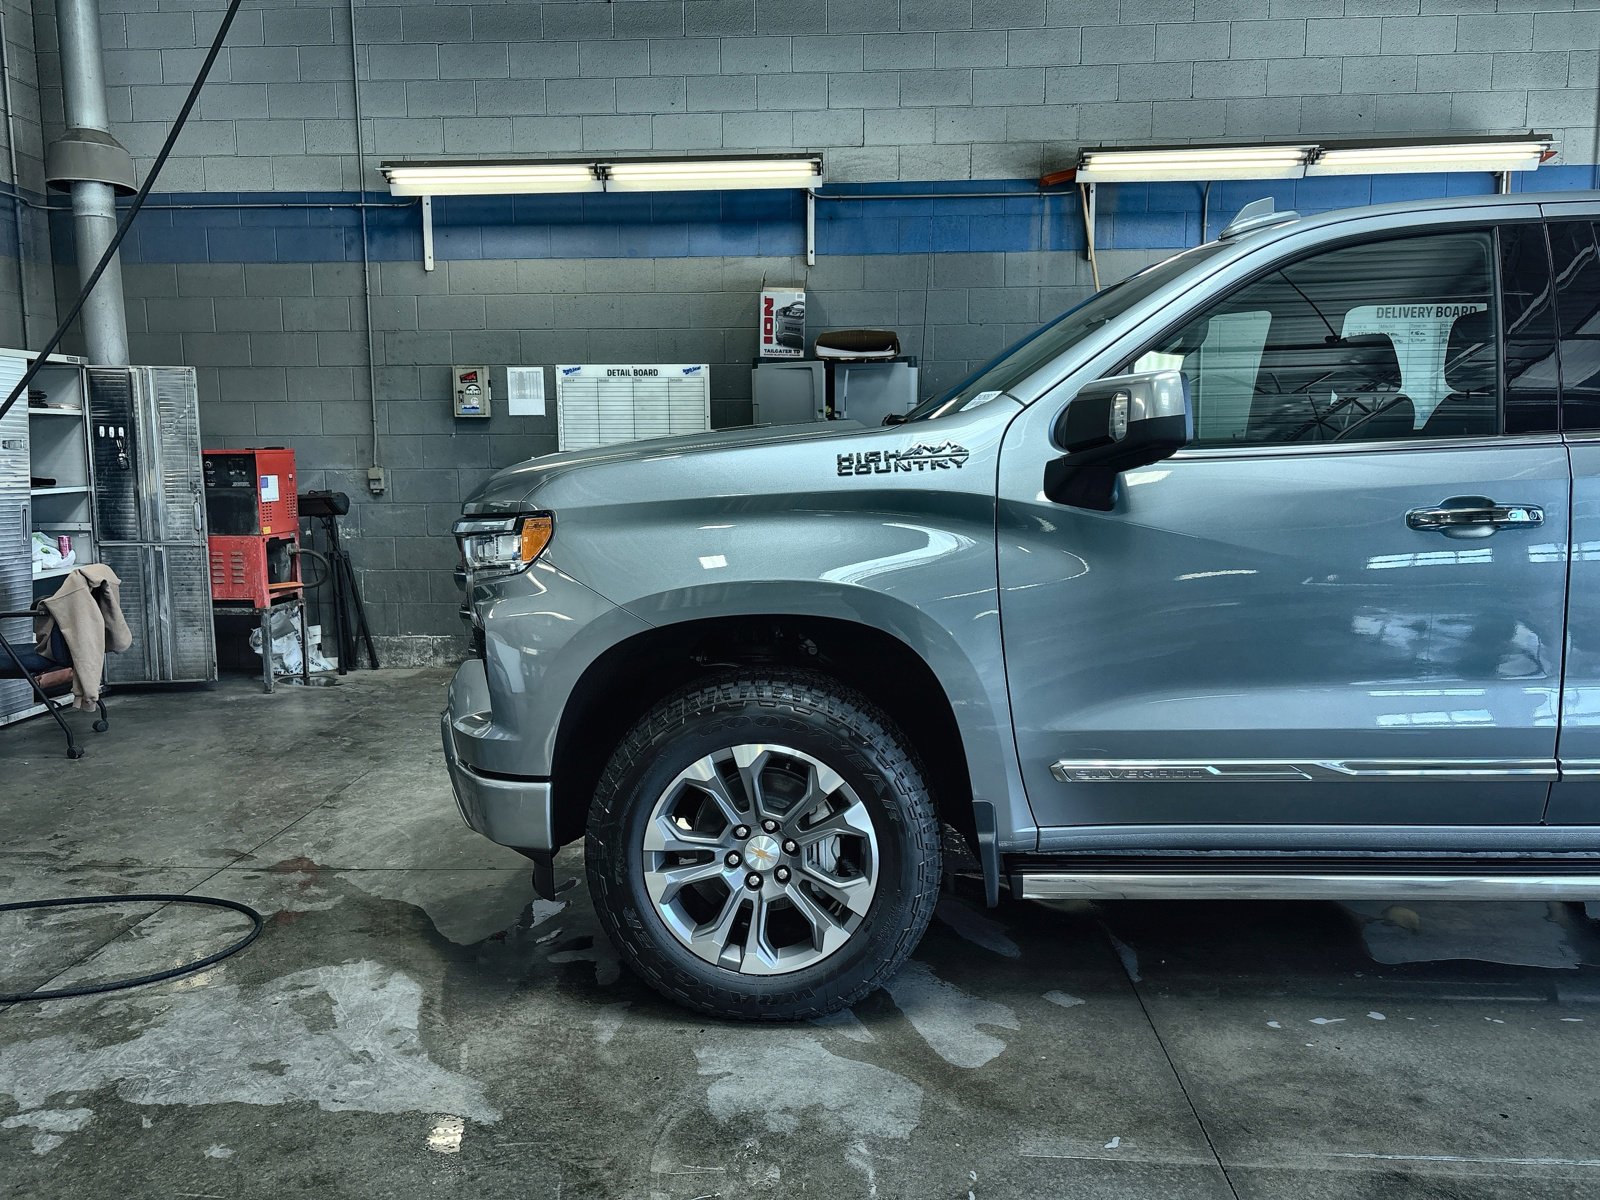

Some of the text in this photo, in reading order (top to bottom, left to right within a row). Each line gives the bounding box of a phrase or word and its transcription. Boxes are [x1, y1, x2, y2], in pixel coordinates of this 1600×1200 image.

[1376, 306, 1434, 319] DELIVERY
[764, 296, 774, 344] ION
[607, 368, 659, 377] DETAIL BOARD
